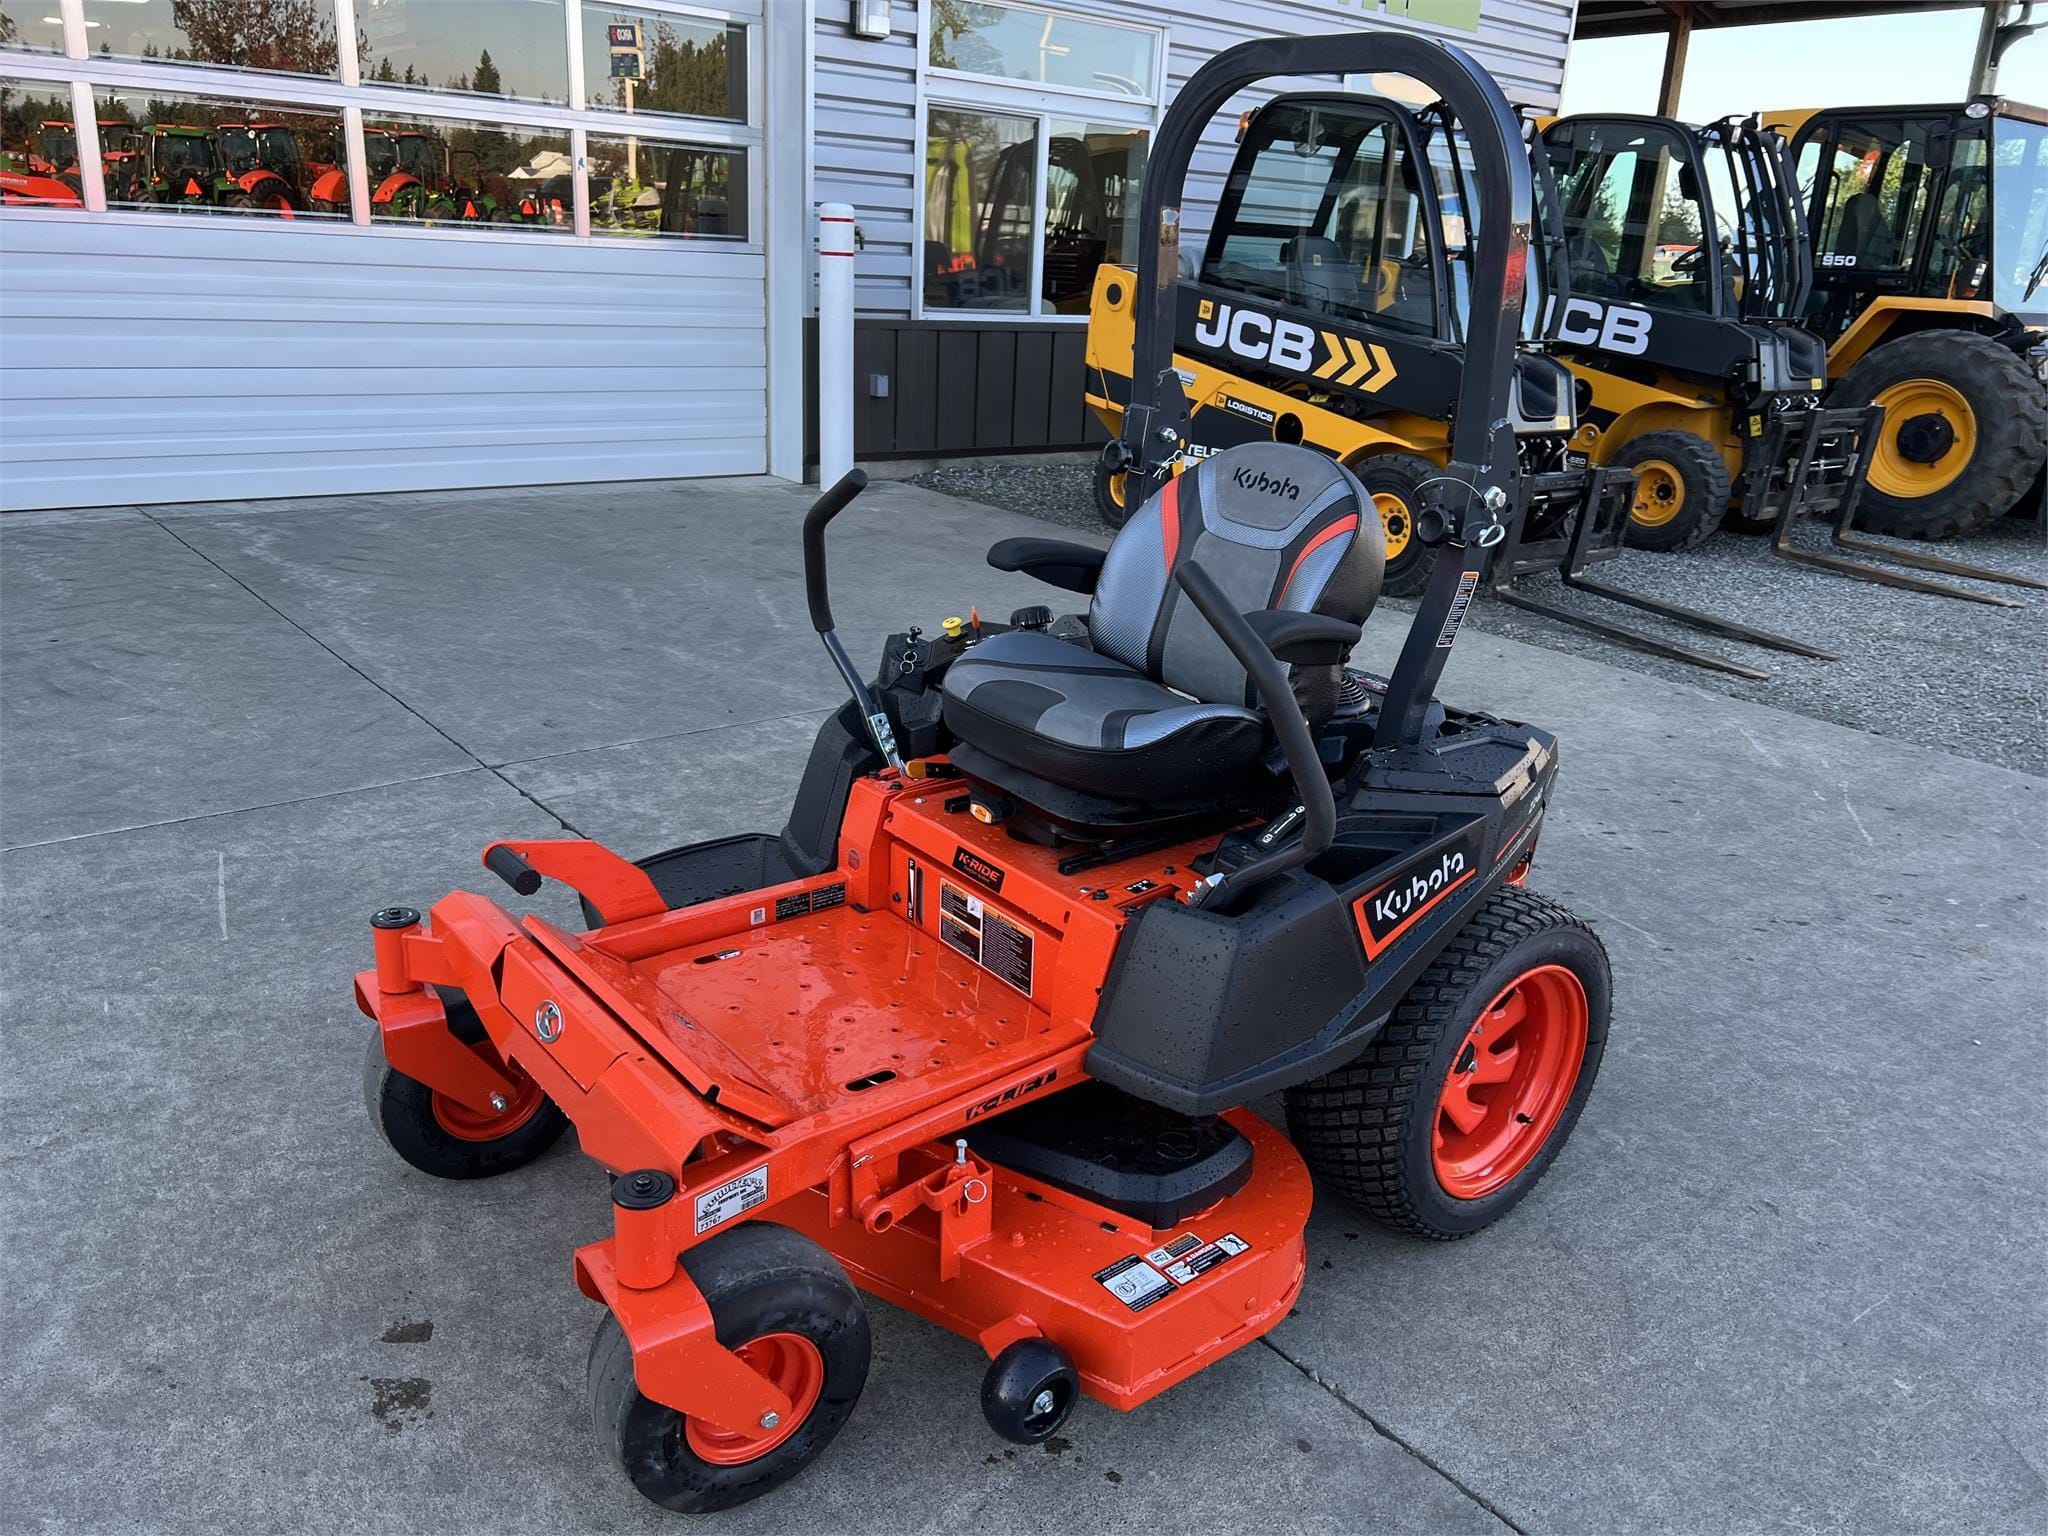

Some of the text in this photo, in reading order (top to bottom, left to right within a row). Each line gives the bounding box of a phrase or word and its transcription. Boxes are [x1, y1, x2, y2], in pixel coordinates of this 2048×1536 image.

[1822, 255, 1857, 266] 950
[1195, 304, 1316, 373] JCB
[1227, 399, 1274, 422] LOGISTICS
[1233, 466, 1301, 501] Kubota
[958, 852, 1001, 882] K-RIDE
[1375, 852, 1465, 921] Kubota
[700, 1215, 721, 1230] 73767
[1191, 1242, 1216, 1258] DANGER
